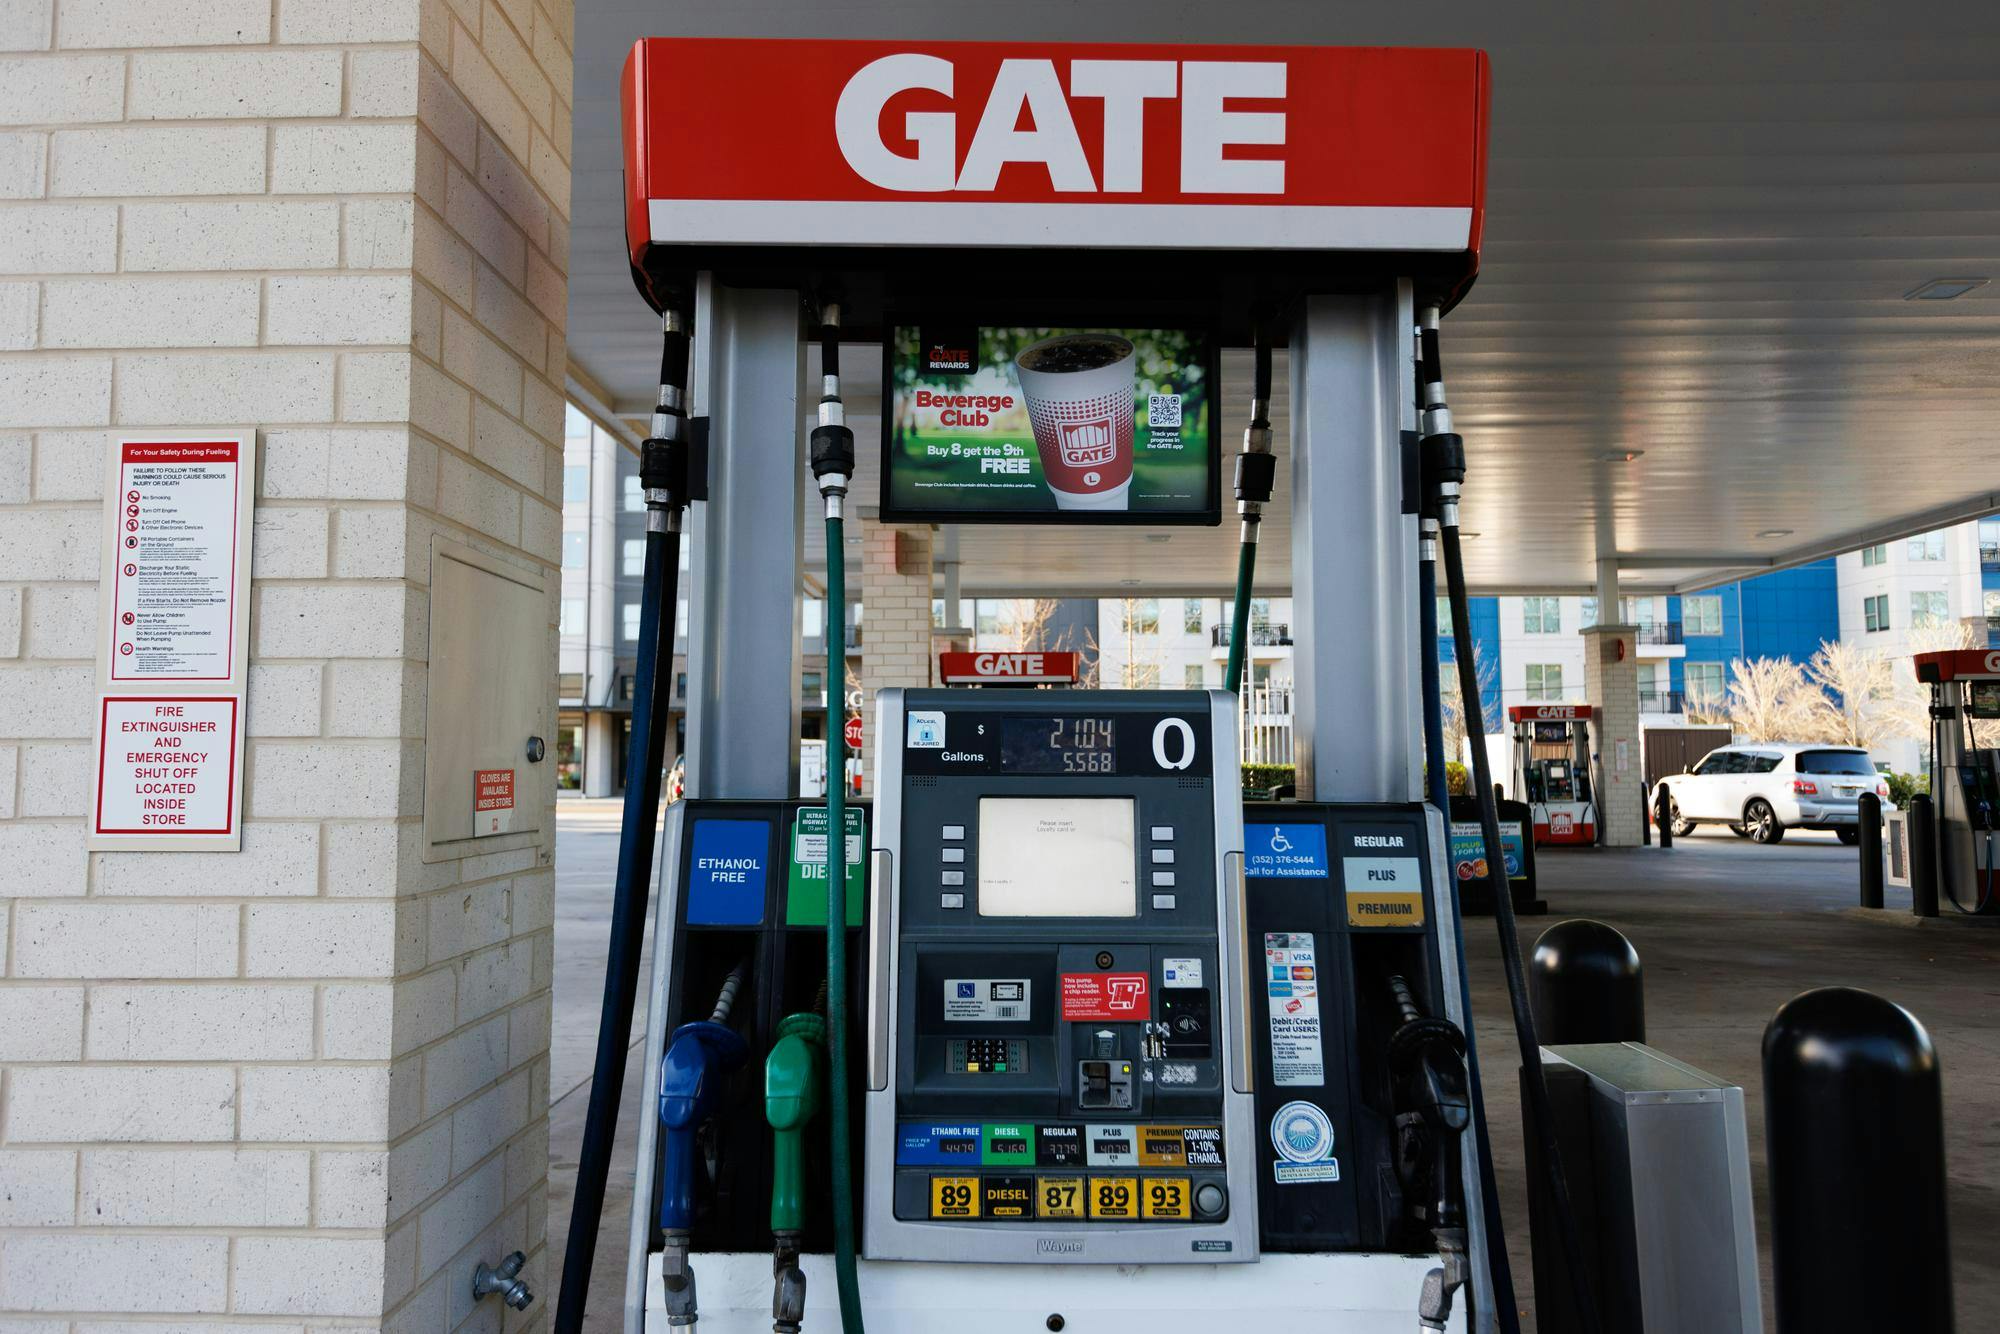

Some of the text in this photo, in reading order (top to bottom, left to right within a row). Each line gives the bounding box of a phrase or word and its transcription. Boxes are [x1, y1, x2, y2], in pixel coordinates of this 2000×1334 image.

[835, 53, 1287, 194] GATE
[917, 391, 1014, 412] Beverage
[940, 410, 989, 426] Club
[928, 443, 1024, 457] Buy 8 get the 9th
[1066, 448, 1112, 462] GATE
[981, 458, 1030, 473] FREE
[975, 655, 1044, 675] GATE
[155, 707, 183, 716] FIRE
[1537, 707, 1575, 718] GATE
[122, 722, 216, 732] EXTINGUISHER
[978, 718, 1112, 748] $ 21.04
[154, 738, 182, 747] AND
[127, 753, 208, 762] EMERGENCY
[942, 752, 1112, 772] Gallons 5.568
[135, 768, 198, 778] SHUT OFF
[480, 774, 511, 783] GLOVES ARE
[136, 784, 196, 793] LOCATED
[483, 786, 509, 796] AVAILABLE
[144, 799, 186, 809] INSIDE
[479, 798, 512, 808] INSIDE STORE
[143, 815, 186, 824] STORE
[1354, 836, 1404, 847] REGULAR
[698, 858, 760, 870] ETHANOL
[1252, 856, 1314, 865] (352) 376-5444
[1244, 867, 1326, 876] Call for Assistance
[1368, 870, 1396, 881] PLUS
[711, 872, 745, 883] FREE
[1358, 903, 1412, 915] PREMIUM
[1043, 1128, 1077, 1136] REGULAR
[1184, 1129, 1220, 1140] CONTAINS
[1192, 1141, 1216, 1151] 1-10%
[1188, 1152, 1222, 1164] ETHANOL
[941, 1185, 971, 1206] 89
[987, 1190, 1029, 1200] DIESEL
[1046, 1187, 1077, 1208] 87
[1099, 1186, 1129, 1207] 89
[1151, 1186, 1181, 1207] 93
[1041, 1240, 1082, 1252] Wayne
